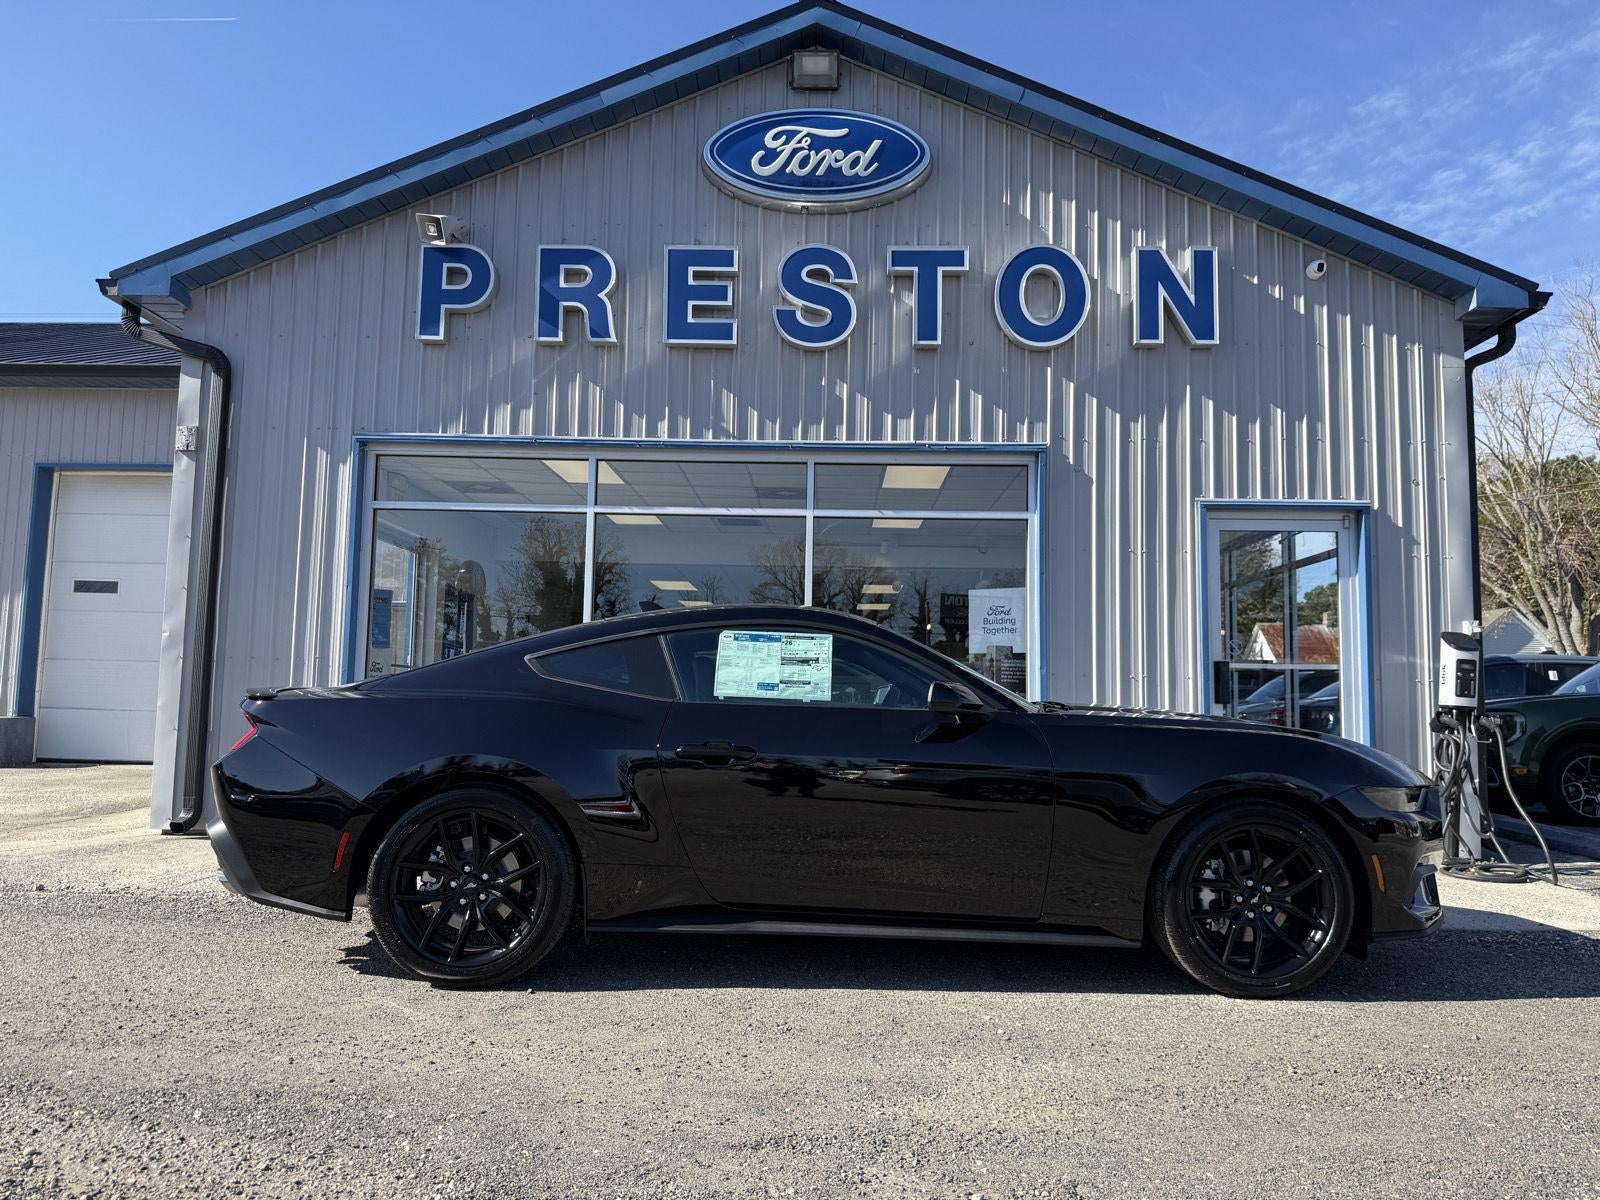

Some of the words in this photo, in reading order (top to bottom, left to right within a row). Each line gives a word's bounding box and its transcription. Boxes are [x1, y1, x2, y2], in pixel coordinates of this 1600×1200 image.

[751, 125, 882, 177] Ford
[415, 243, 1219, 347] PRESTON
[986, 605, 1012, 616] Ford
[983, 617, 1016, 626] Building
[982, 626, 1018, 635] Together
[369, 661, 384, 673] Ford
